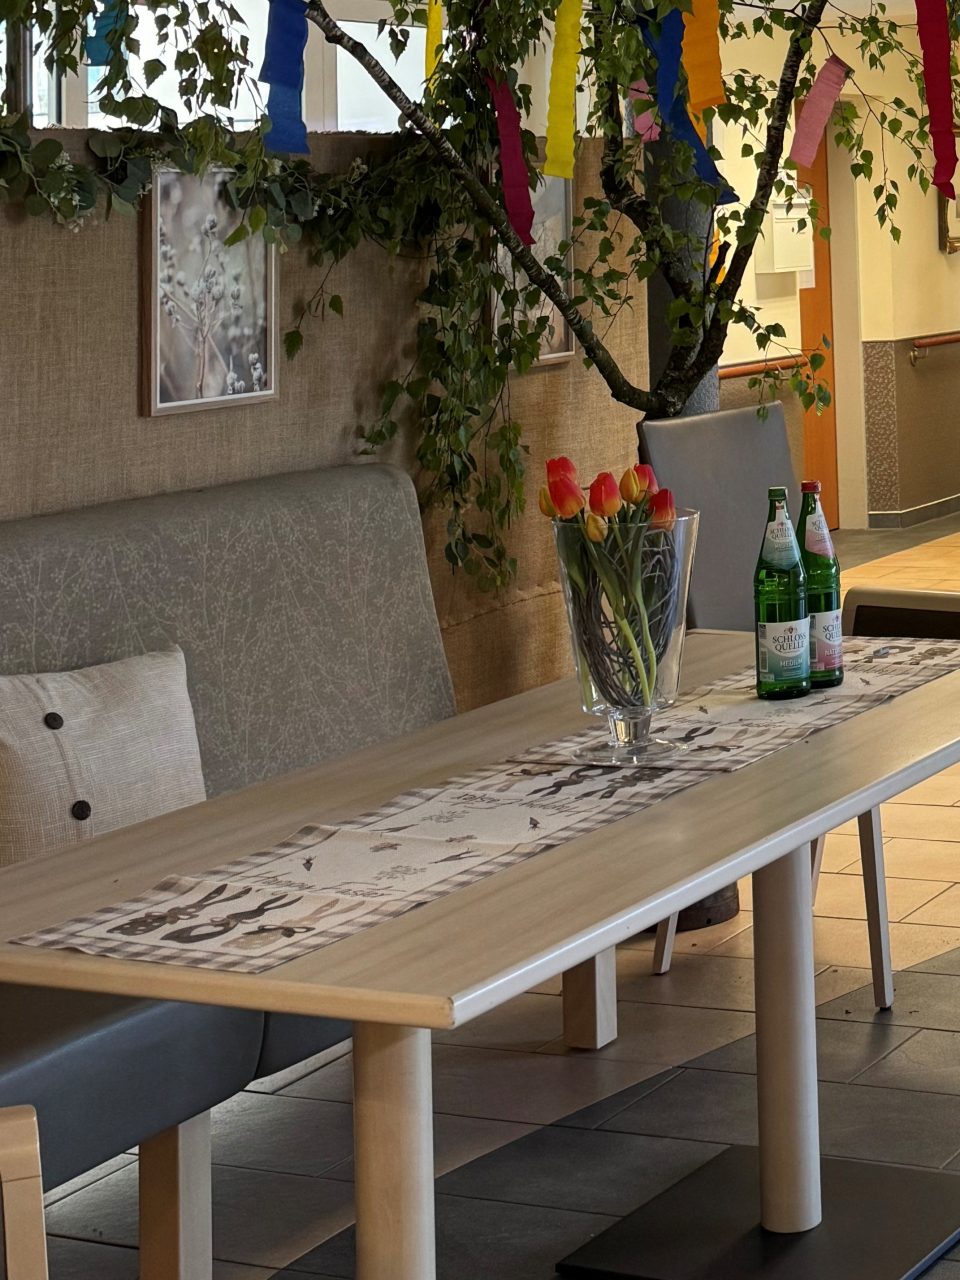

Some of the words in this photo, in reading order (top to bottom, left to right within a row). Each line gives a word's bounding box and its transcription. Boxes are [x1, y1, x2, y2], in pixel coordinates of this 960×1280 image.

[772, 631, 807, 644] SCHLOSS
[774, 640, 805, 653] QUELLE
[780, 657, 803, 667] MEDIUM
